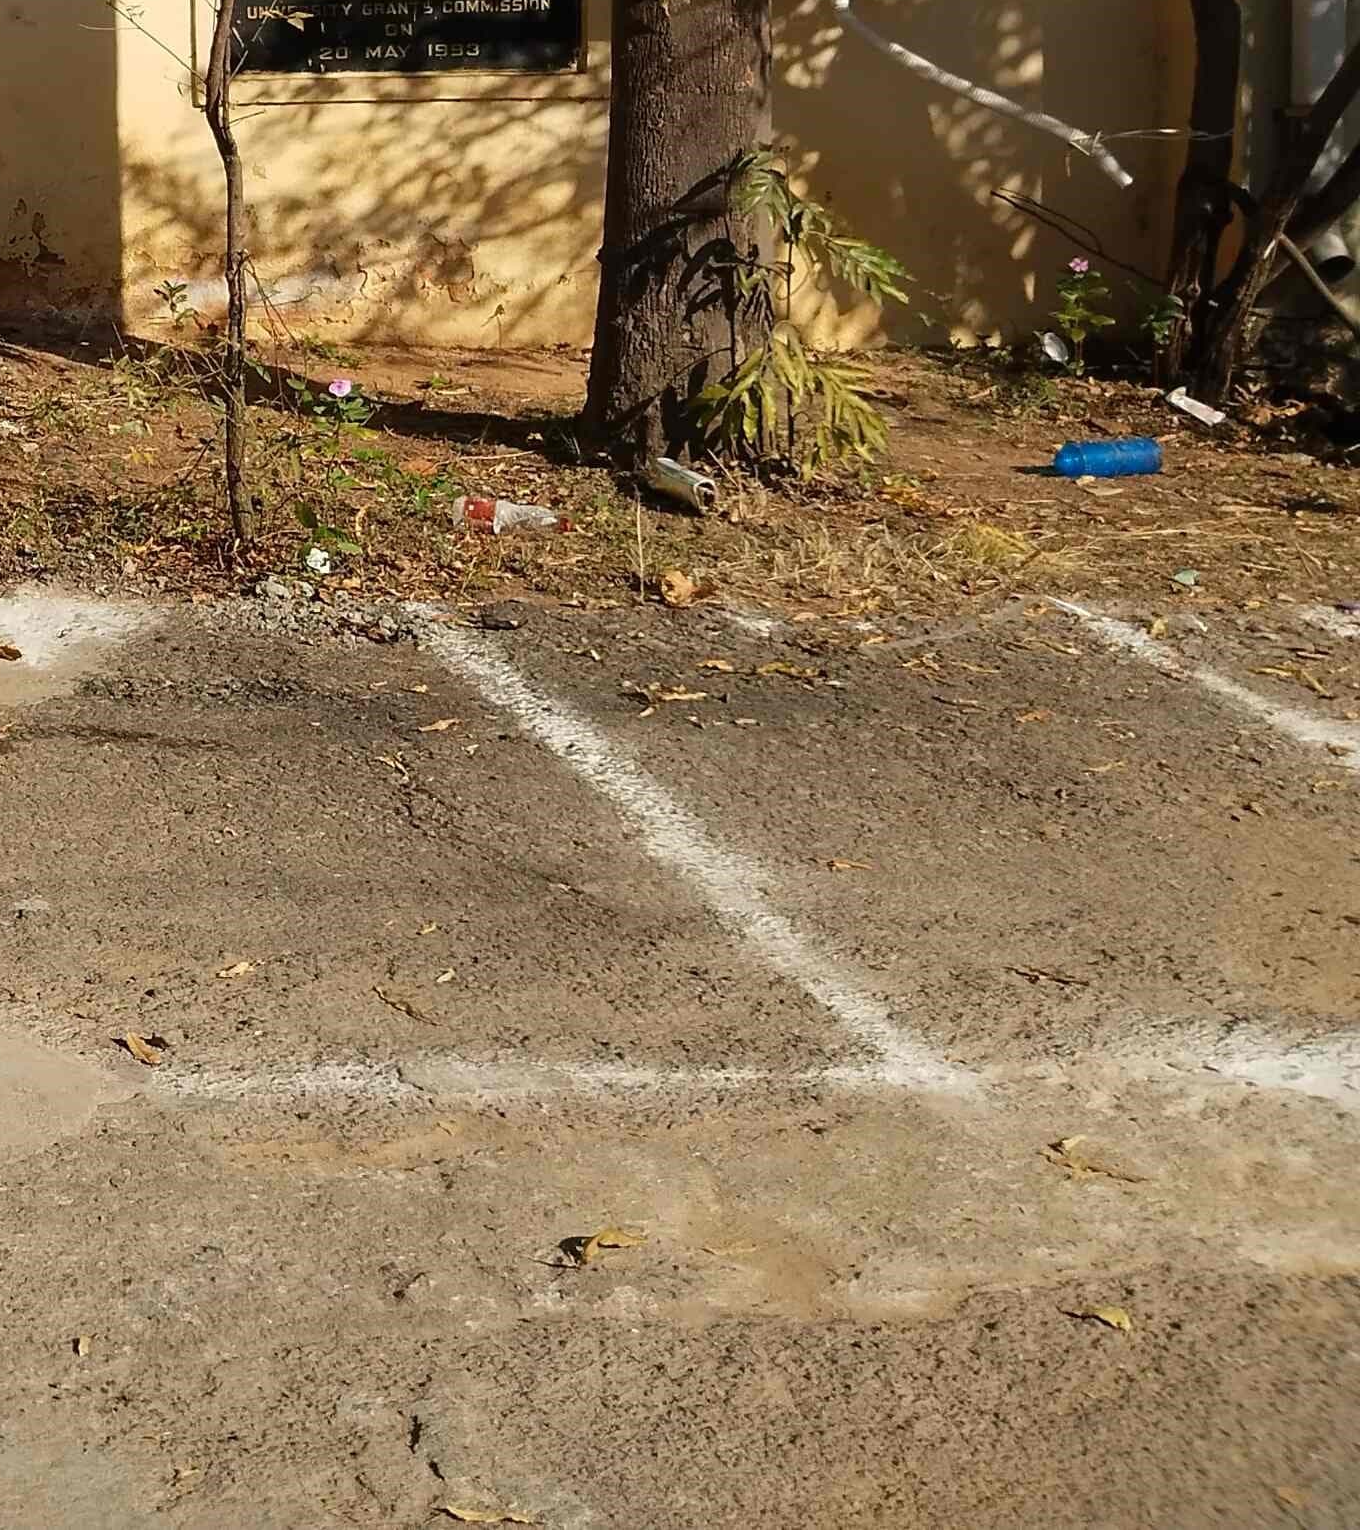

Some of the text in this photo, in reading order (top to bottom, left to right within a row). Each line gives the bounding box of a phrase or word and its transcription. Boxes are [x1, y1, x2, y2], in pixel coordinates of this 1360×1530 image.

[362, 1, 434, 16] GRANTS
[384, 23, 413, 37] ON
[319, 47, 349, 60] 20
[365, 45, 409, 60] MAY
